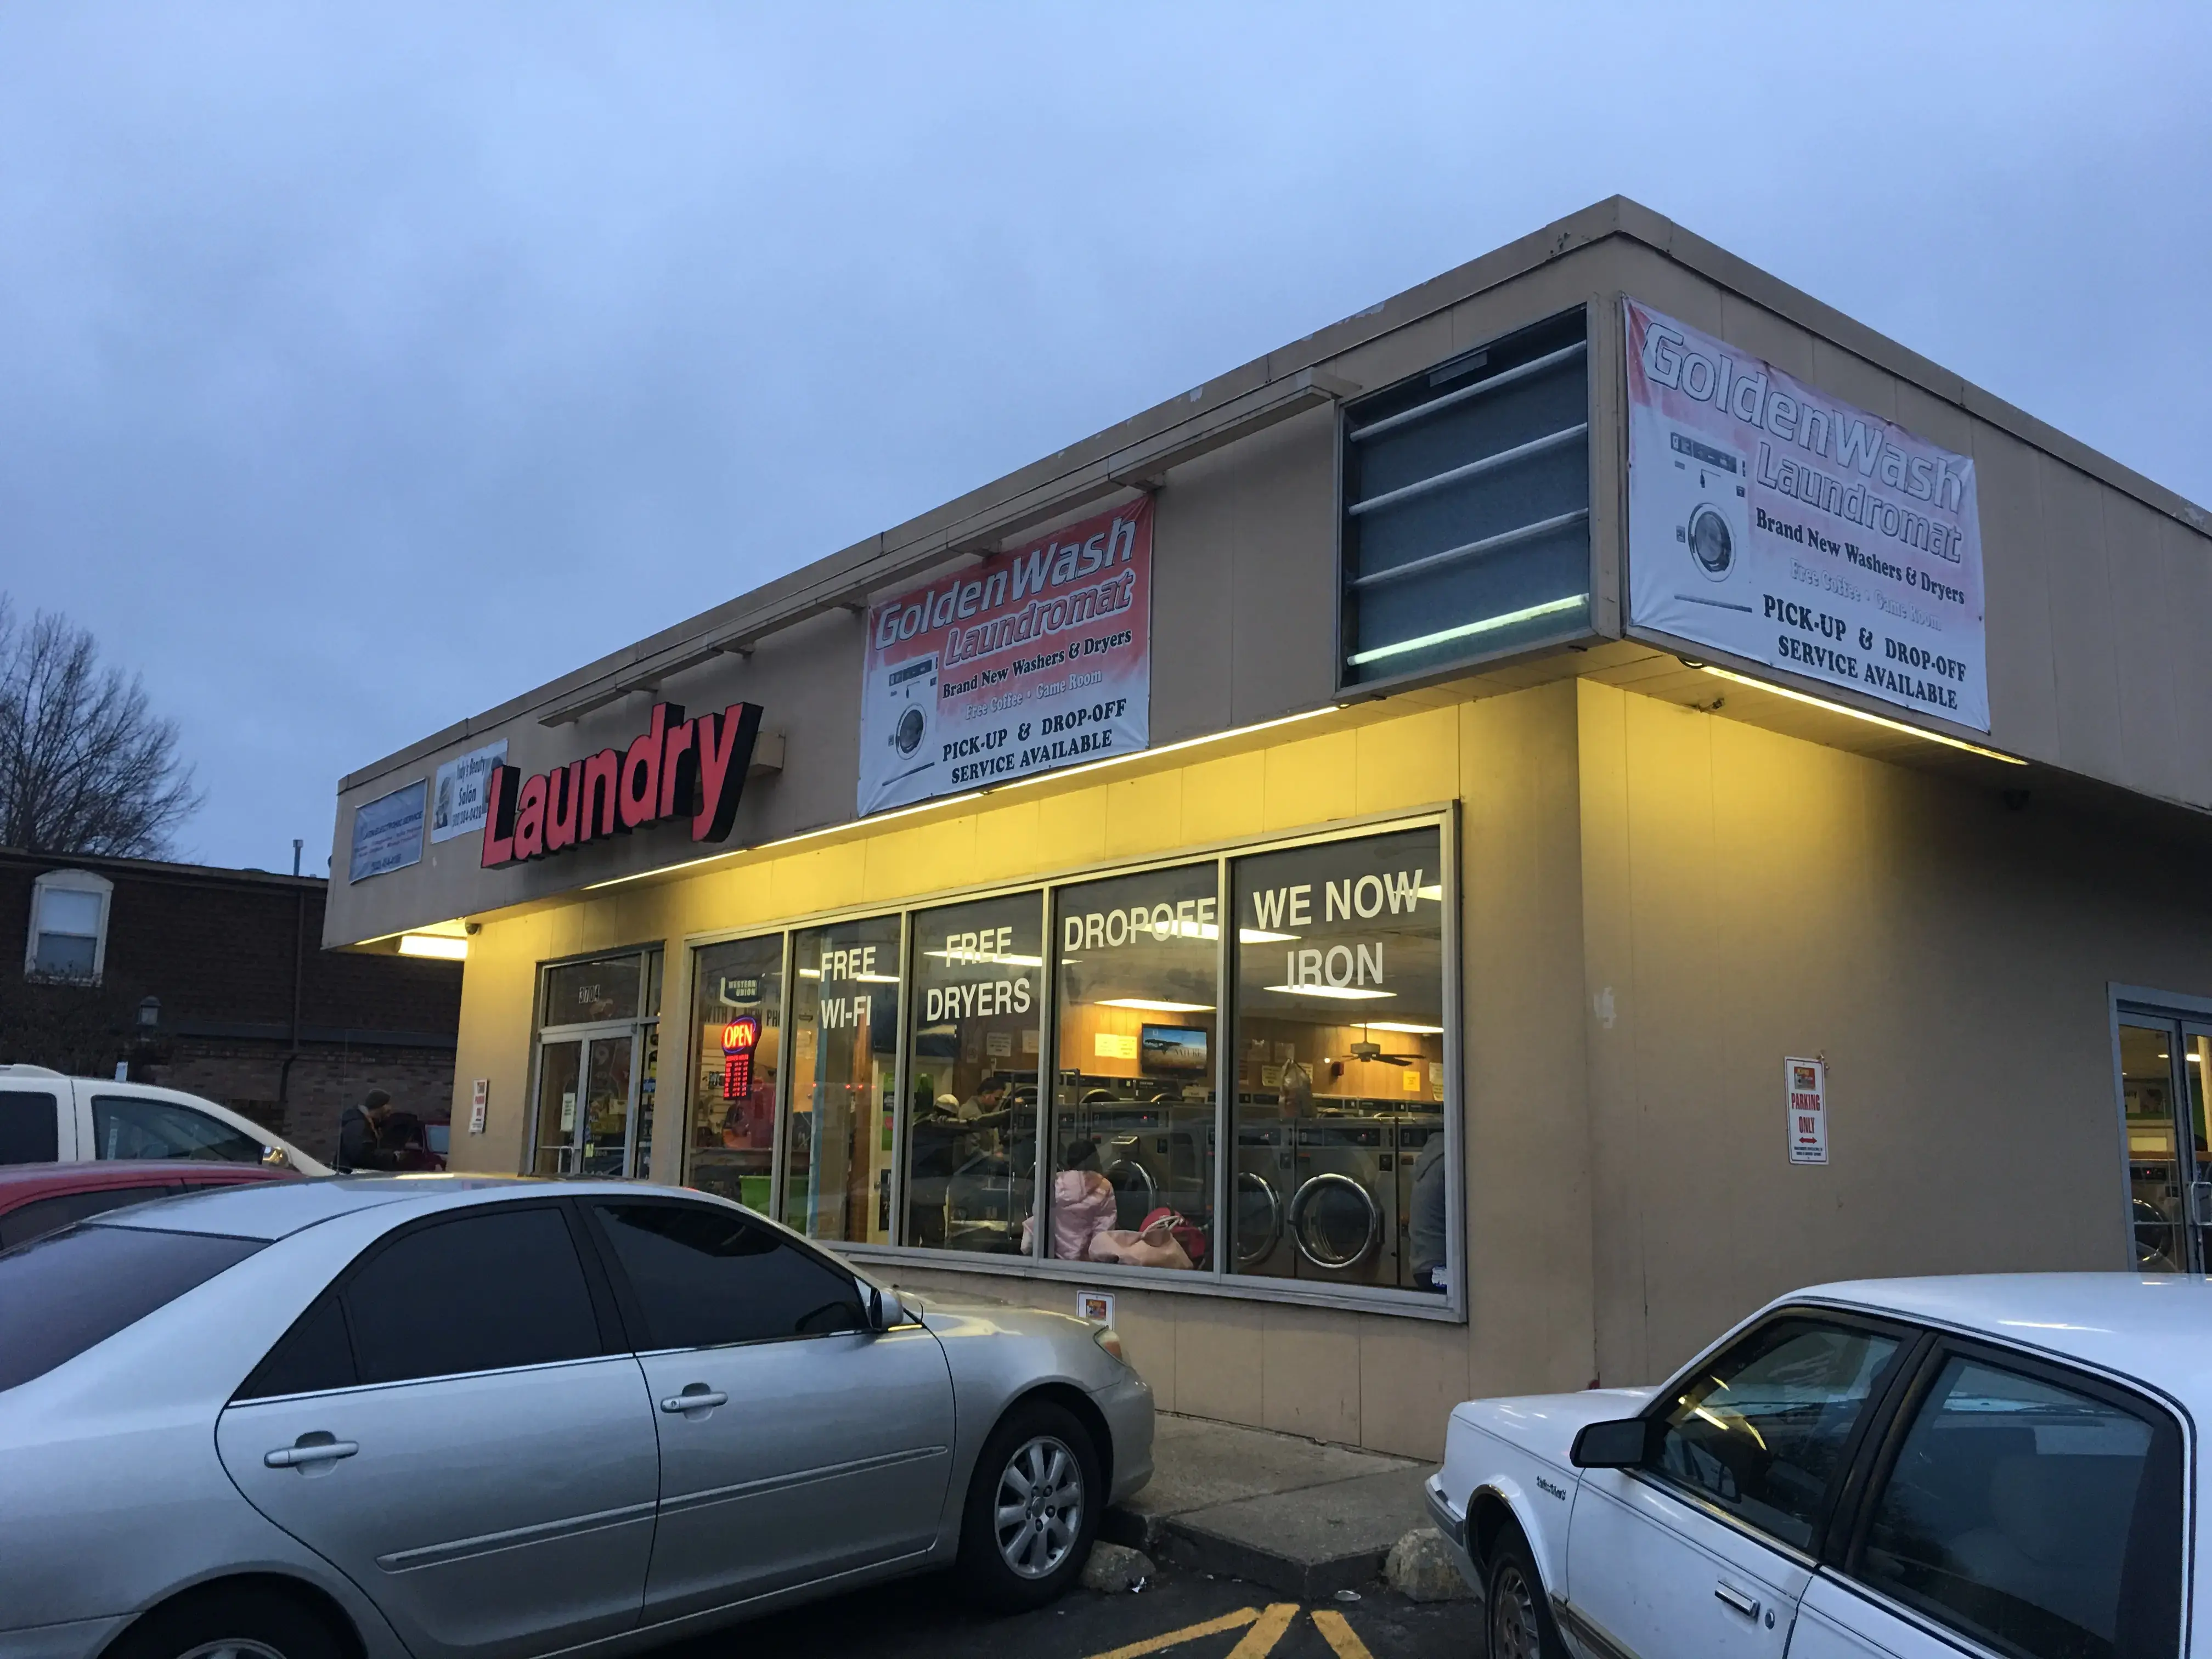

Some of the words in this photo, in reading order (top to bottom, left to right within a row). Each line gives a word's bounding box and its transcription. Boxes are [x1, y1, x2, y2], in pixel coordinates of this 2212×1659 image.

[1643, 321, 1962, 515] GoldenWash
[1756, 441, 1962, 564] Laundromat
[876, 516, 1137, 650] GoldenWash
[1756, 507, 1803, 543] Brand
[1807, 529, 1841, 557] New
[1844, 543, 1902, 584] Washers
[1905, 567, 1917, 586] &
[1920, 571, 1965, 605] Dryers
[945, 568, 1135, 667] Laundromat
[1790, 557, 1820, 588] Free
[1821, 570, 1861, 602] Coffee
[1875, 589, 1907, 618] Game
[1910, 601, 1943, 632] Room
[943, 675, 978, 698] Brand
[981, 668, 1008, 686] New
[1012, 650, 1064, 676] Washers
[1069, 642, 1080, 659] &
[1084, 630, 1131, 656] Dryers
[1763, 594, 1846, 642] PICK-UP
[1859, 628, 1873, 650] &
[1884, 637, 1967, 682] DROP-OFF
[965, 703, 987, 720] Free
[990, 690, 1023, 713] Coffee
[1036, 681, 1066, 699] Game
[1069, 669, 1102, 691] Room
[1778, 634, 1858, 679] SERVICE
[1864, 664, 1958, 710] AVAILABLE
[943, 729, 1007, 761] PICK-UP
[1018, 723, 1030, 741] &
[1042, 698, 1126, 736] DROP-OFF
[951, 753, 1014, 784] SERVICE
[1019, 729, 1111, 768] AVAILABLE
[481, 701, 764, 868] Laundry
[1064, 897, 1216, 952] DROPOFF
[1253, 884, 1311, 930] WE
[1325, 868, 1423, 922] NOW
[821, 946, 876, 982] FREE
[946, 926, 1012, 968] FREE
[1287, 942, 1383, 990] IRON
[729, 980, 757, 989] WESTERN
[736, 988, 757, 997] UNION
[927, 978, 1030, 1022] DRYERS
[725, 1024, 753, 1048] OPEN
[821, 996, 871, 1029] WI-FI
[1175, 1048, 1200, 1057] NATURE
[1791, 1093, 1820, 1111] PARKING
[1798, 1116, 1815, 1133] ONLY
